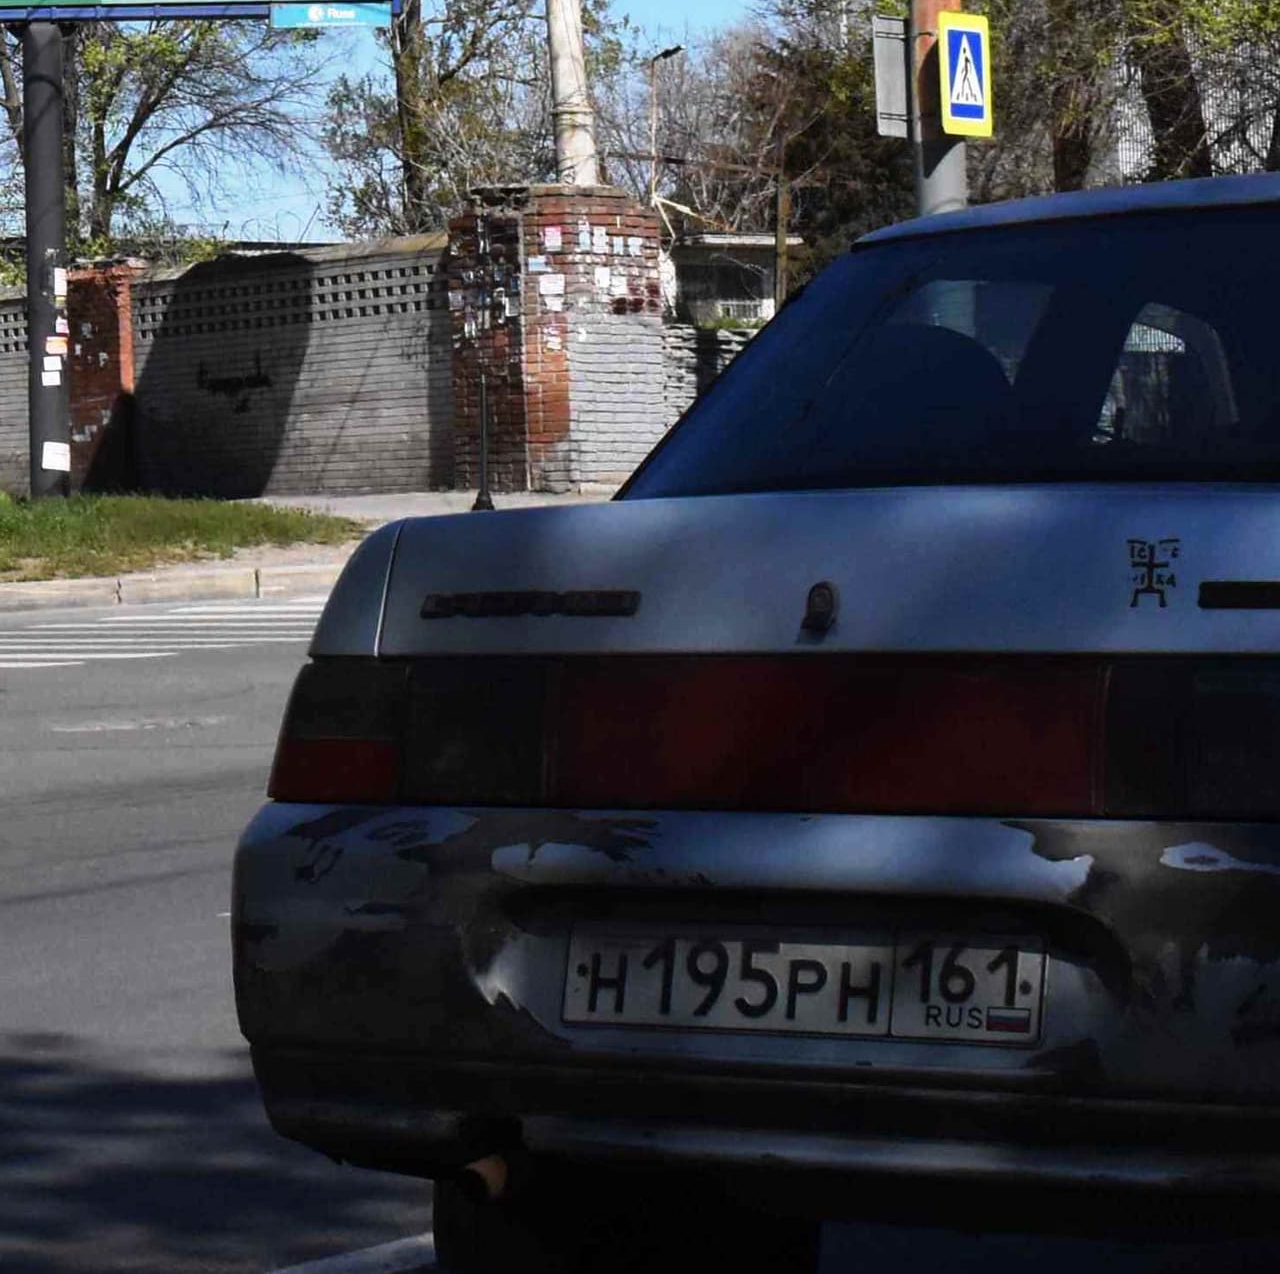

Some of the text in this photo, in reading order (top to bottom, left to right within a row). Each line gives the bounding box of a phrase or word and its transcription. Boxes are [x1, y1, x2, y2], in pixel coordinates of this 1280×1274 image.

[586, 935, 1021, 1024] Н195РН 161
[925, 1005, 982, 1030] RUS
